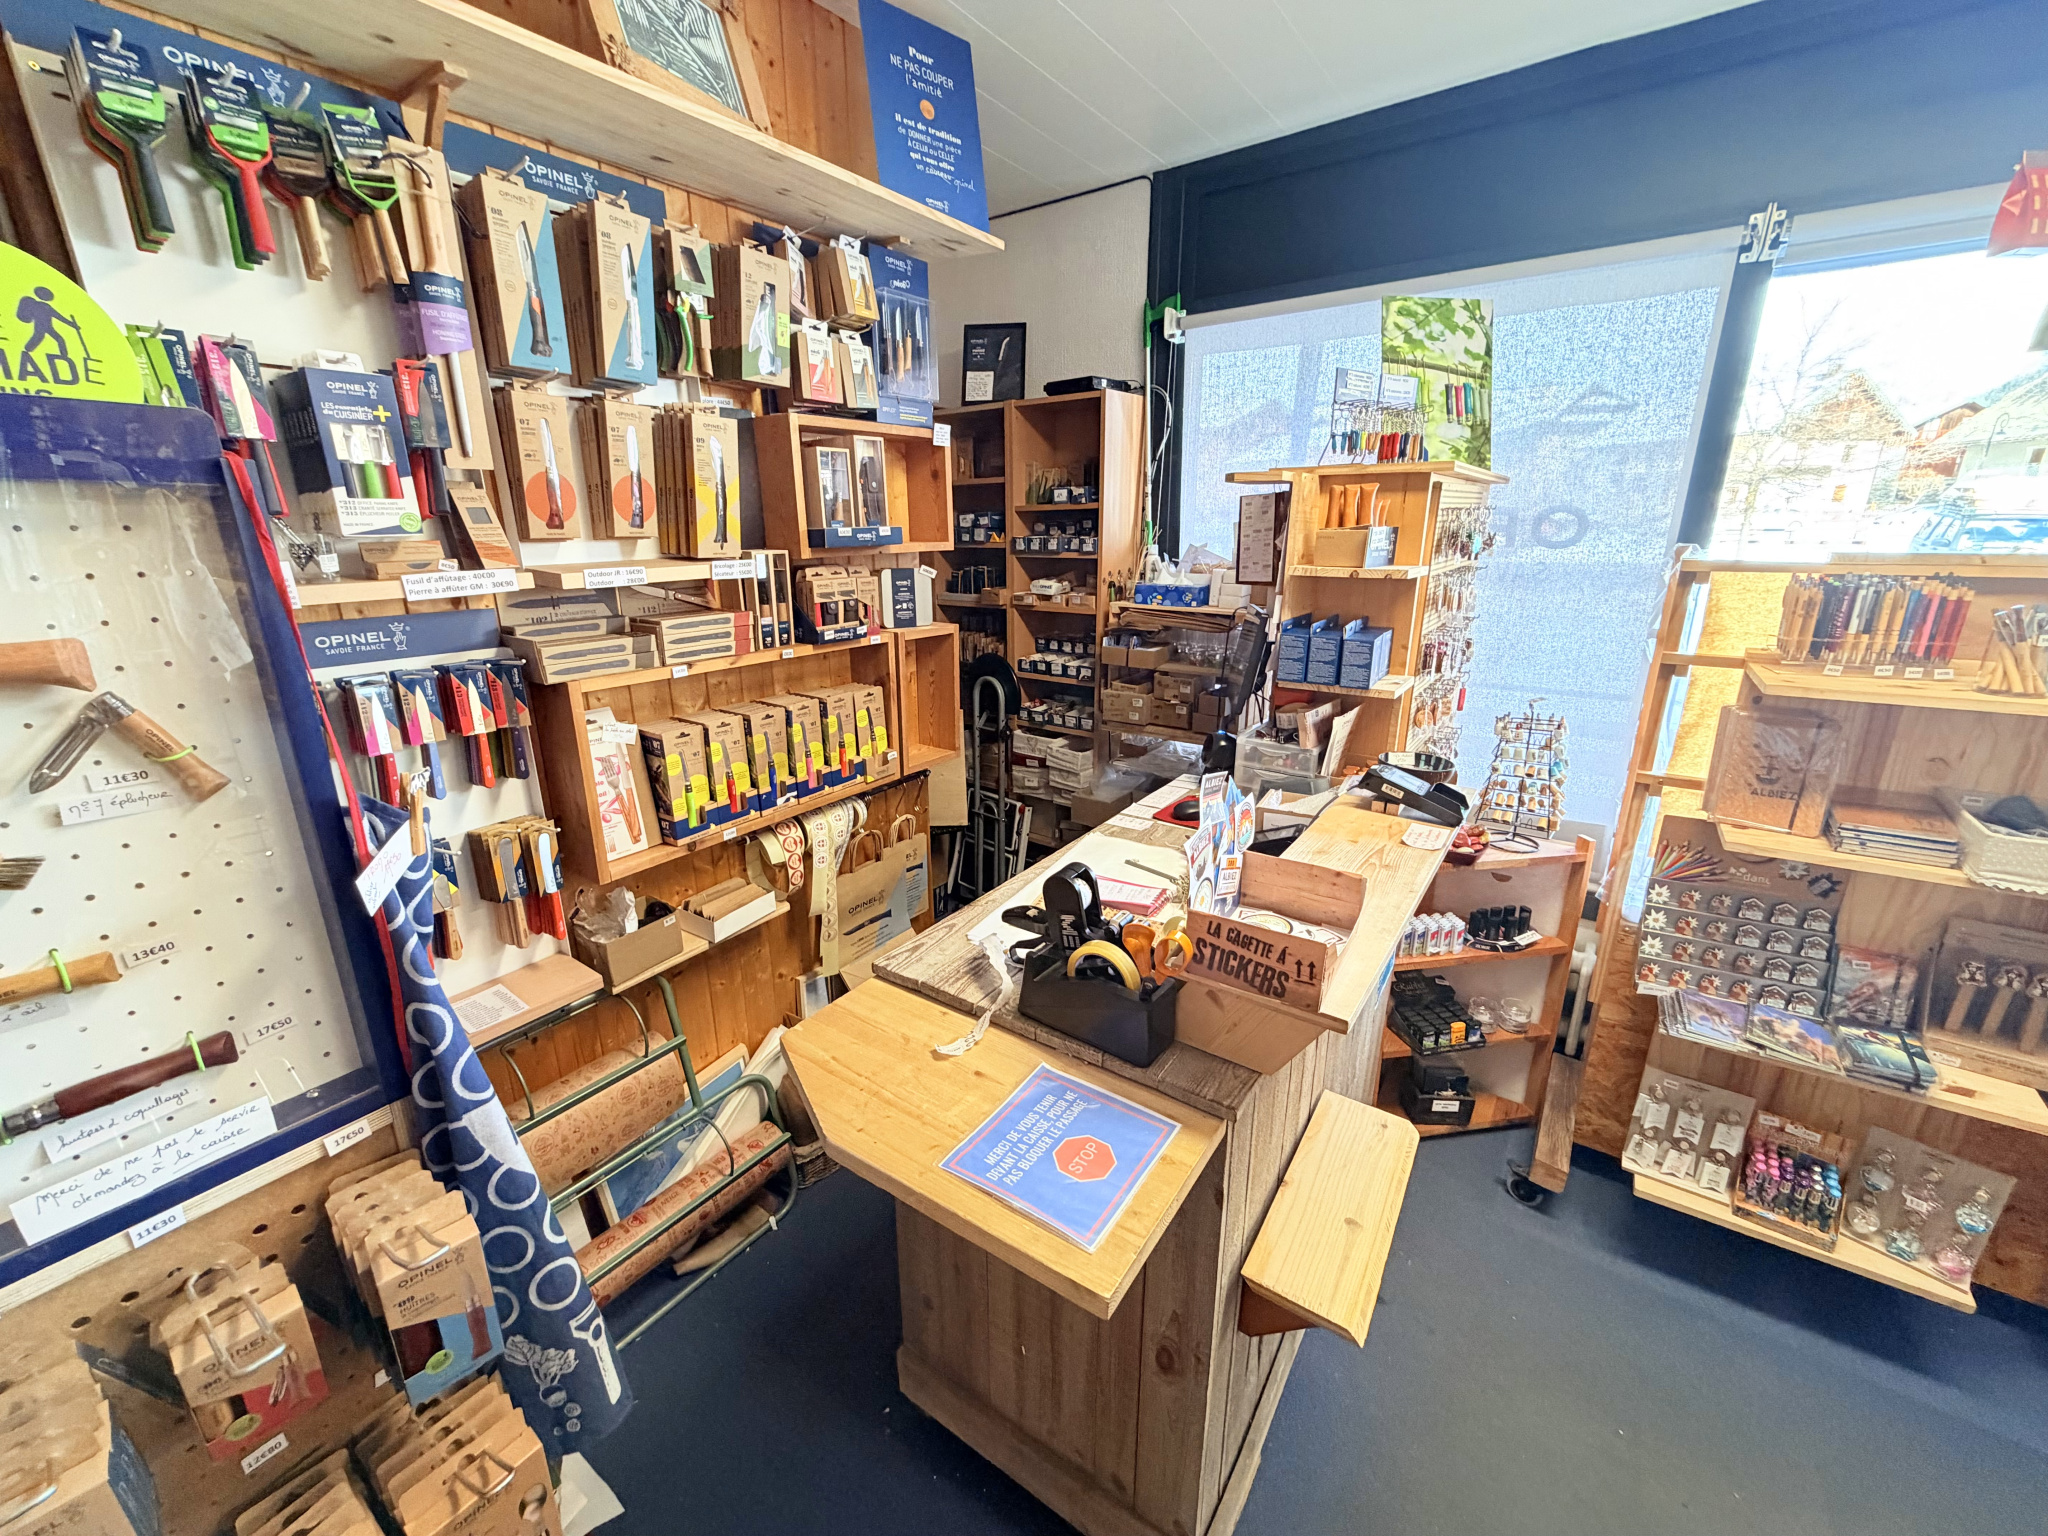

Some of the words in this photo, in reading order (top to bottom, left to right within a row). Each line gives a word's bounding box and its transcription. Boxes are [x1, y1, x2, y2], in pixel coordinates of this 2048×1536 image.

[908, 46, 934, 66] Pour
[163, 45, 265, 90] OPINEL
[890, 53, 902, 69] NE
[904, 59, 920, 76] PAS
[922, 67, 954, 90] COUPER
[905, 73, 943, 98] l'amitié
[898, 125, 906, 135] de
[908, 128, 931, 145] DONNER
[932, 138, 943, 147] une
[945, 141, 962, 155] pièce
[903, 116, 915, 127] est
[917, 121, 927, 132] de
[928, 125, 962, 145] tradition
[910, 152, 922, 162] qui
[923, 156, 938, 166] vous
[939, 159, 955, 171] offre
[929, 147, 938, 156] ou
[938, 149, 955, 162] CELLE
[524, 162, 583, 189] OPINEL
[916, 163, 924, 171] un
[532, 175, 553, 188] SAVOIE
[556, 182, 579, 196] FRANCE
[498, 189, 528, 204] OPINEL
[608, 214, 633, 228] OPINEL
[755, 259, 773, 272] OPINEL
[885, 256, 907, 268] OPINEL
[424, 284, 457, 296] OPINEL
[326, 381, 368, 393] OPINEL
[334, 404, 372, 413] essentiels
[523, 401, 551, 410] OPINEL
[334, 411, 374, 421] CUISINIER
[615, 411, 639, 420] OPINEL
[406, 577, 423, 585] Fusil
[426, 575, 467, 584] d'affûtage
[588, 570, 613, 578] Outdoor
[408, 588, 433, 596] Pierre
[441, 584, 468, 593] affûter
[491, 580, 514, 588] 30€90
[314, 631, 391, 648] OPINEL
[325, 645, 353, 656] SAVOIE
[356, 643, 386, 652] FRANCE
[145, 728, 174, 753] OPINEL
[102, 770, 149, 787] 11€30
[1750, 788, 1799, 800] ALBIEZ
[1222, 871, 1237, 881] ALBIEZ
[848, 896, 878, 915] OPINEL
[1207, 920, 1221, 939] LA
[132, 941, 175, 963] 13€40
[1193, 937, 1290, 998] STICKERS
[256, 1016, 293, 1038] 17€50
[333, 1127, 365, 1147] 17€50
[984, 1142, 1011, 1166] MERCI
[1007, 1130, 1019, 1144] DE
[1015, 1111, 1037, 1133] VOUS
[1033, 1094, 1056, 1115] TENIR
[985, 1155, 1017, 1182] DEVANT
[1016, 1140, 1029, 1155] LA
[1025, 1117, 1055, 1144] CAISSE,
[1047, 1099, 1068, 1120] POUR
[1064, 1090, 1078, 1102] NE
[1002, 1169, 1024, 1187] PAS
[1017, 1136, 1052, 1171] BLOQUER
[1050, 1126, 1062, 1140] LE
[1057, 1099, 1088, 1130] PASSAGE
[1068, 1141, 1100, 1175] STOP
[36, 1182, 84, 1216] Merci
[94, 1165, 113, 1182] de
[124, 1155, 144, 1171] ne
[155, 1135, 180, 1159] pas
[190, 1125, 206, 1145] se
[72, 1173, 149, 1210] demandez
[151, 1160, 164, 1174] à
[174, 1148, 197, 1166] la
[201, 1128, 252, 1154] caisse
[135, 1214, 178, 1241] 11€30
[398, 1258, 453, 1289] OPINEL
[202, 1335, 267, 1373] OINEL
[453, 1492, 501, 1532] OPINE
